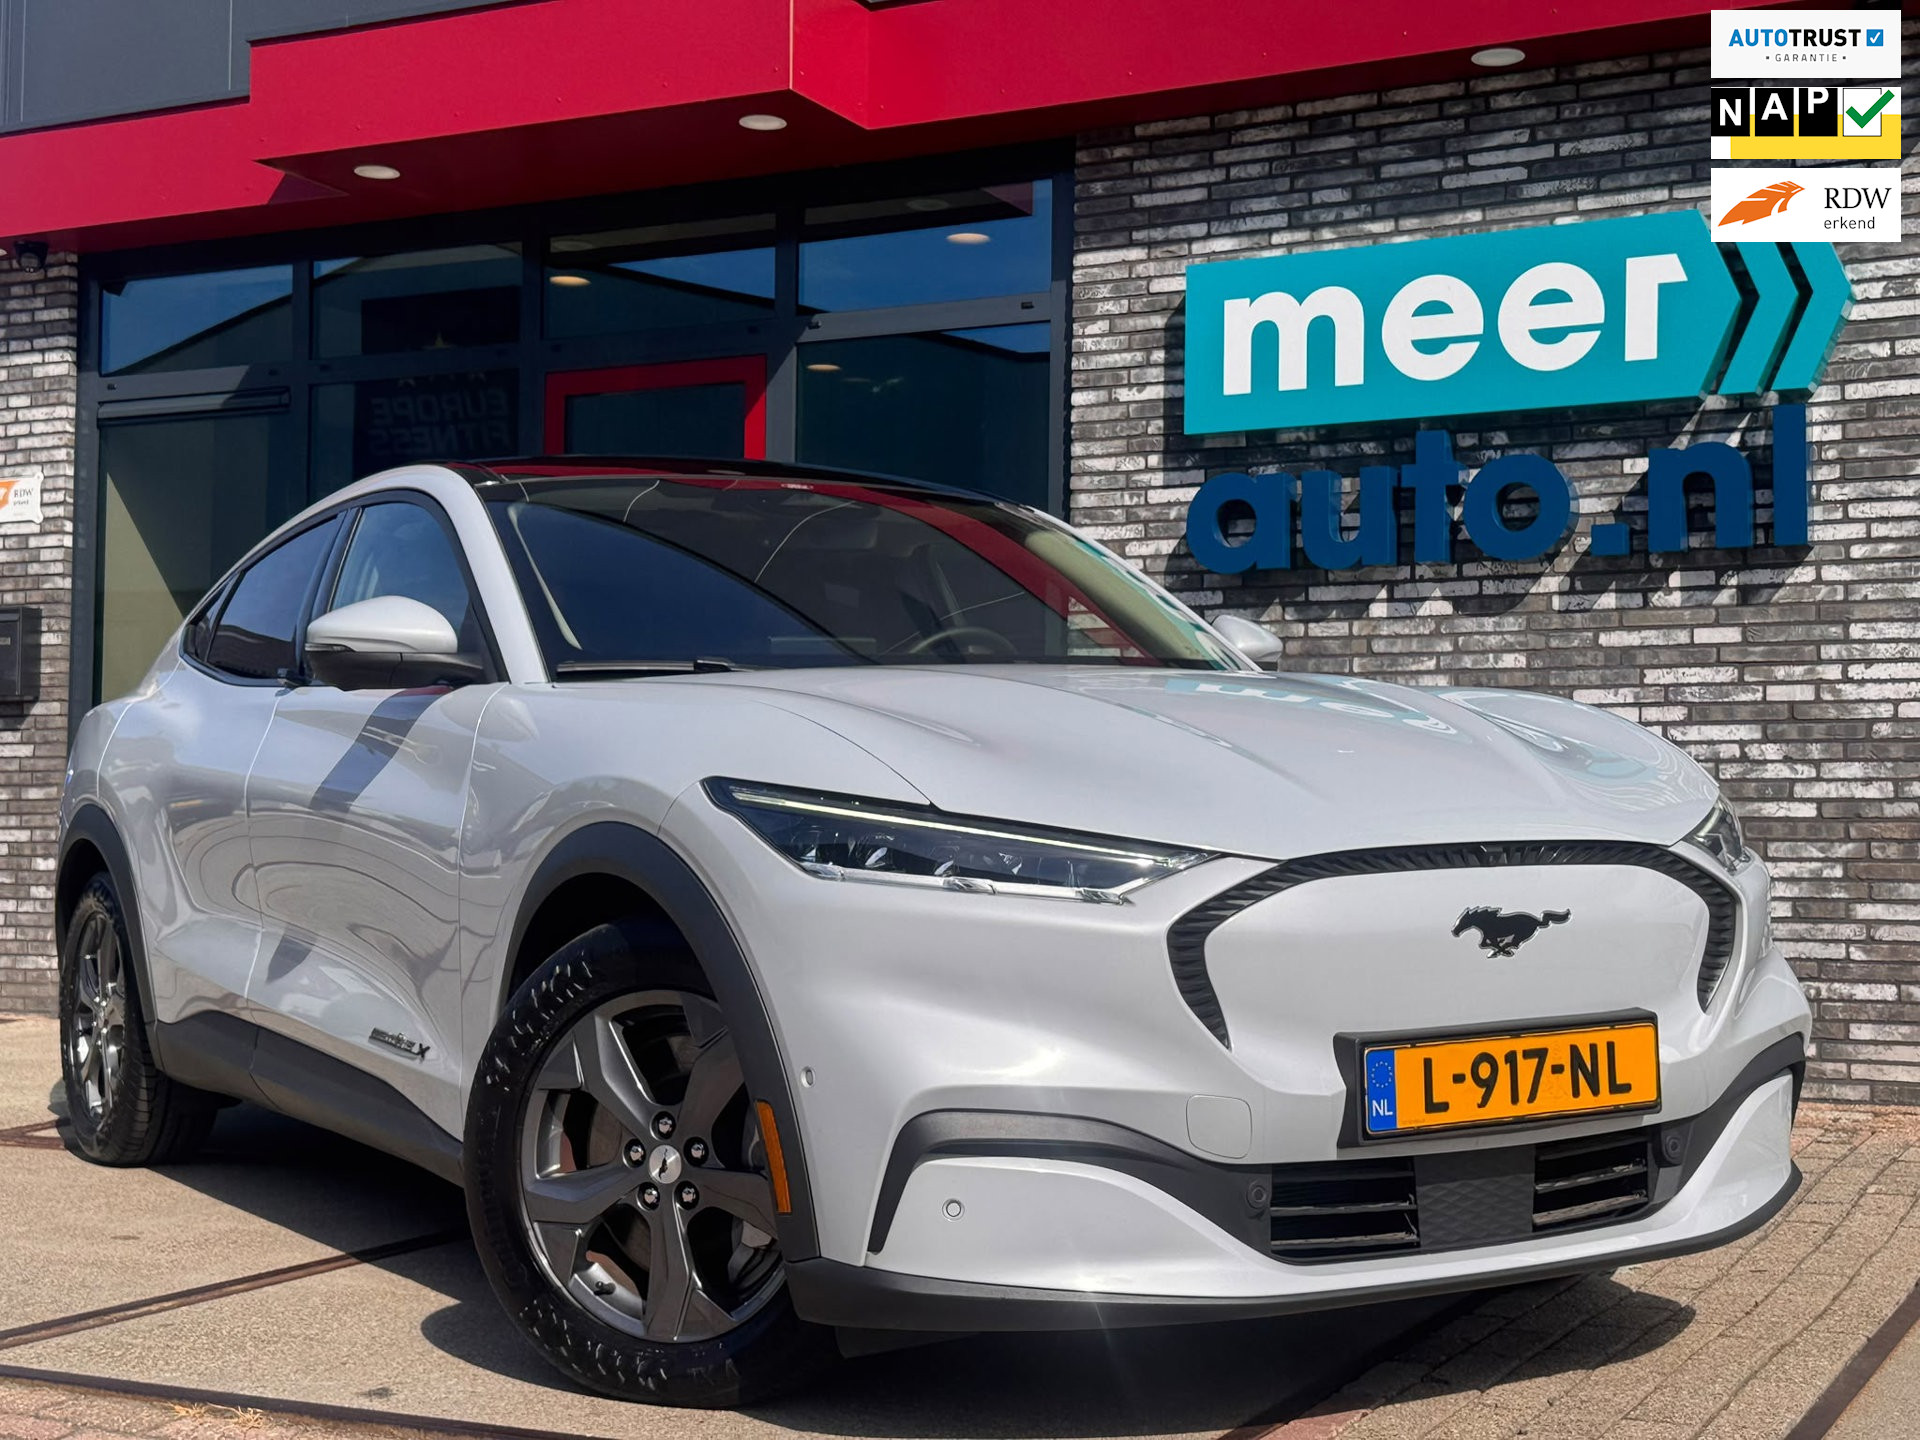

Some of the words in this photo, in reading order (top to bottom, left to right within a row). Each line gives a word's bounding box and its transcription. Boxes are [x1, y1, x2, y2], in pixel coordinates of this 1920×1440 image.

[1222, 252, 1689, 396] meer
[1186, 403, 1809, 575] auto.nl
[1371, 1098, 1394, 1118] NL
[1422, 1040, 1633, 1115] L-917-NL
